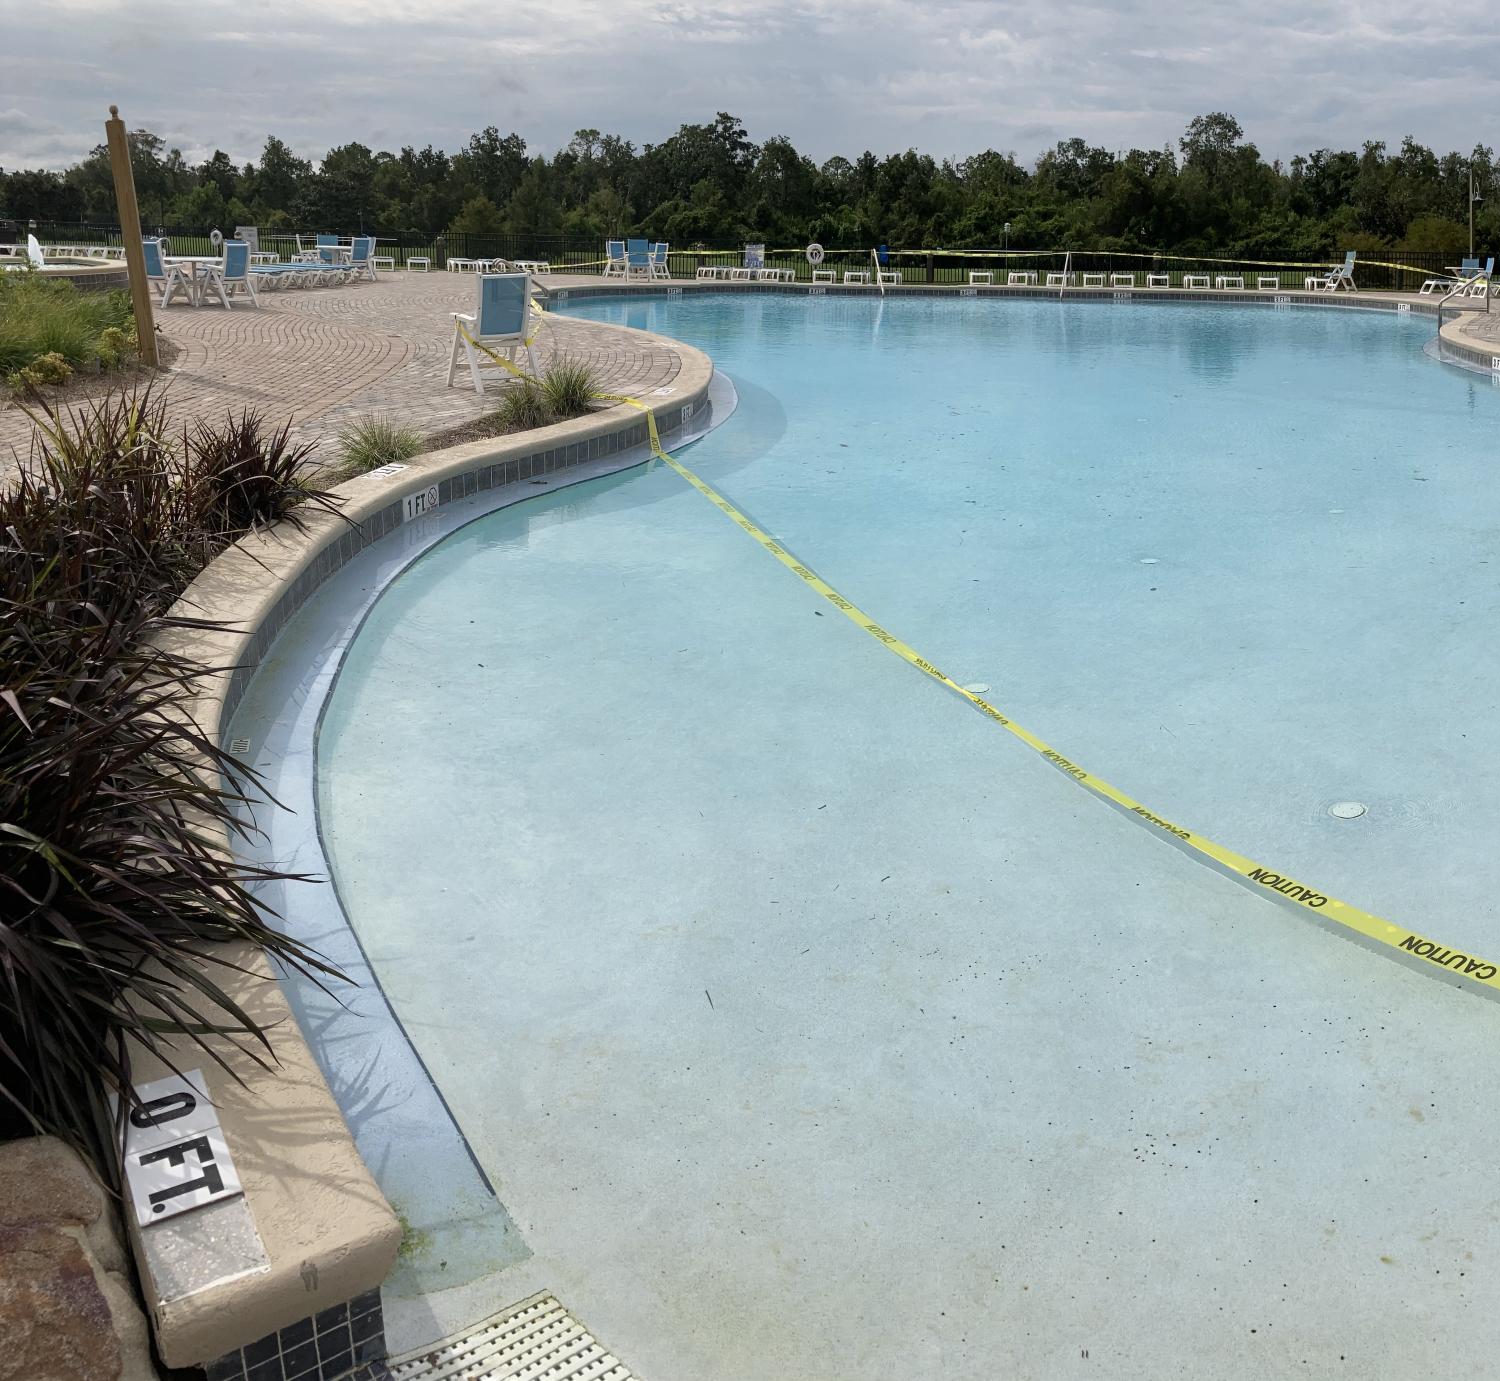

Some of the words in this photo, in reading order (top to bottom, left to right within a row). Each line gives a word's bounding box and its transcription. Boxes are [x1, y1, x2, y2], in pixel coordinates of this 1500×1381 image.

[408, 499, 412, 518] 1
[1248, 868, 1328, 908] CAUTION
[1399, 935, 1498, 980] CAUTION
[129, 1092, 197, 1129] 0
